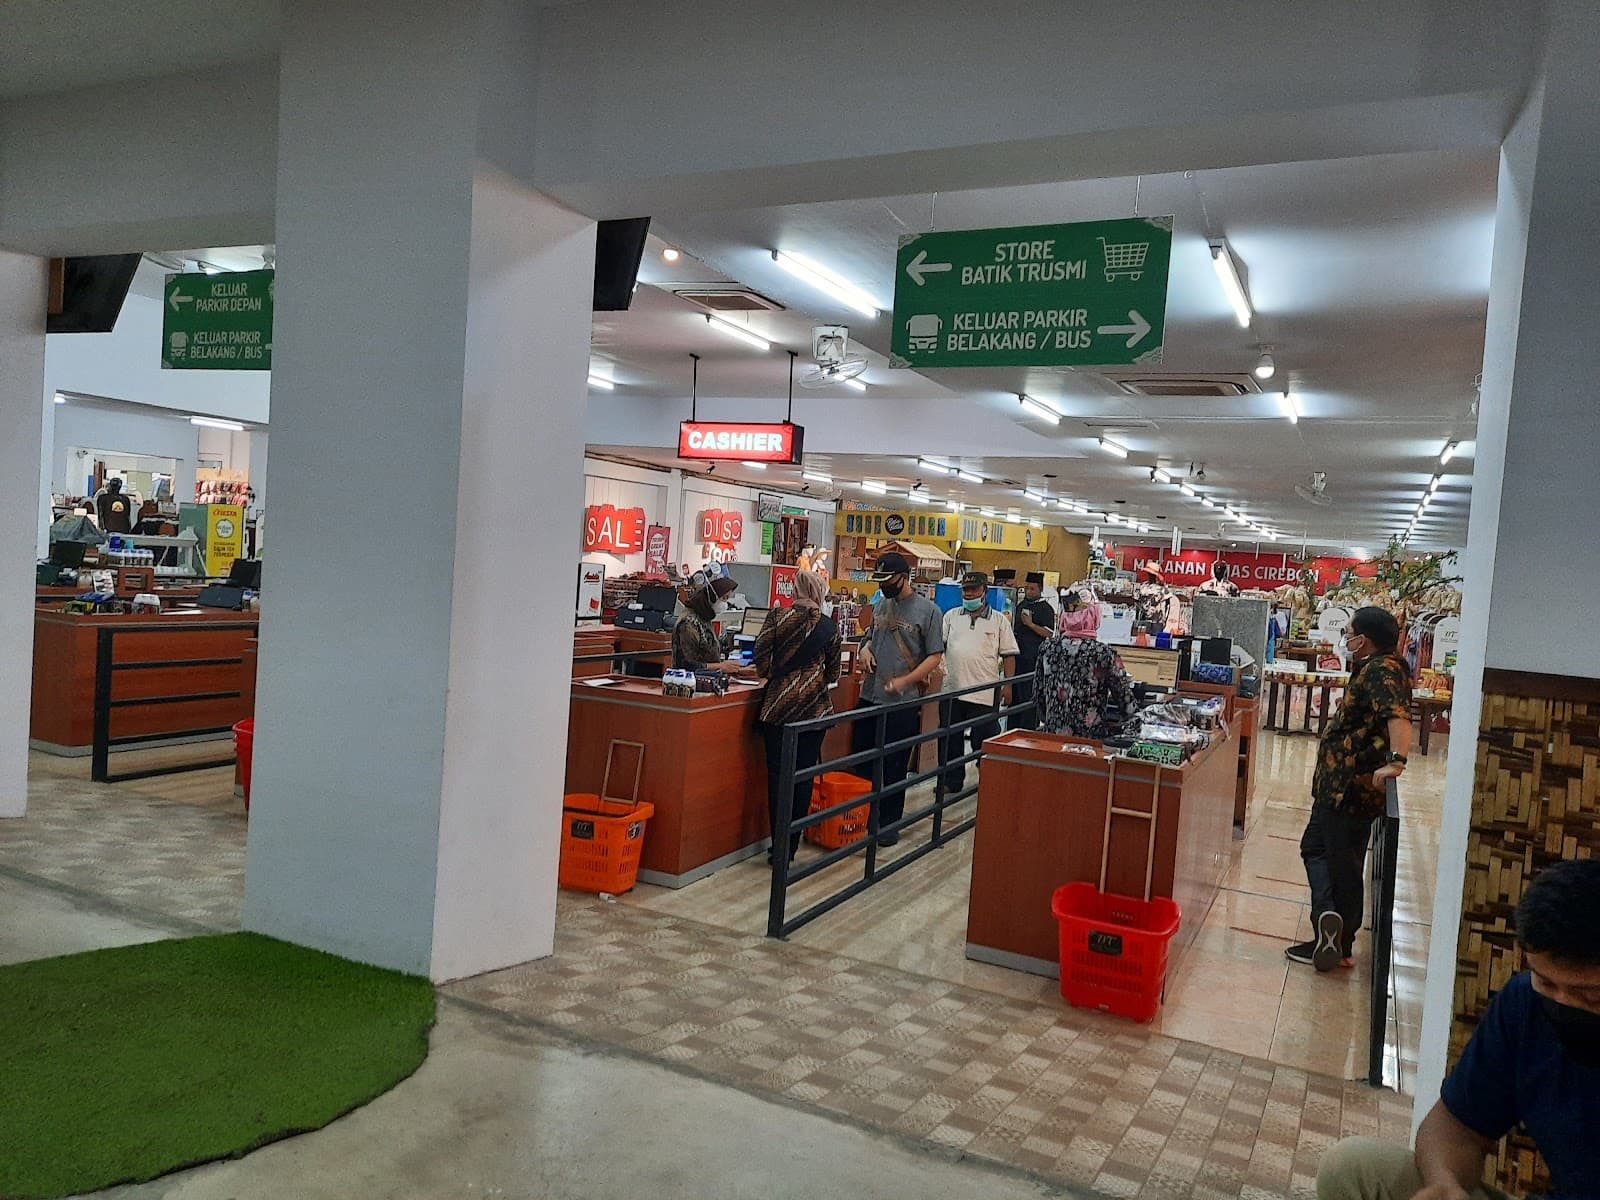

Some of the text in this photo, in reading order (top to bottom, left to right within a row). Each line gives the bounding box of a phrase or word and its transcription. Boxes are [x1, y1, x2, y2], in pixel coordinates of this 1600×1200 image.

[995, 240, 1055, 261] STORE
[962, 260, 1086, 285] BATIK TRUSMI
[211, 283, 247, 297] KELUAR
[196, 297, 261, 312] PARKIR DEPAN
[953, 309, 1087, 330] KELUAR PARKIR
[193, 332, 261, 345] KELUAR PARKIR
[947, 329, 1092, 351] BELAKANG / BUS
[190, 345, 236, 359] BELAKANG
[244, 345, 263, 359] BUS
[688, 431, 783, 452] CASHIER
[586, 516, 643, 548] SALE
[1133, 558, 1206, 575] MKANAN
